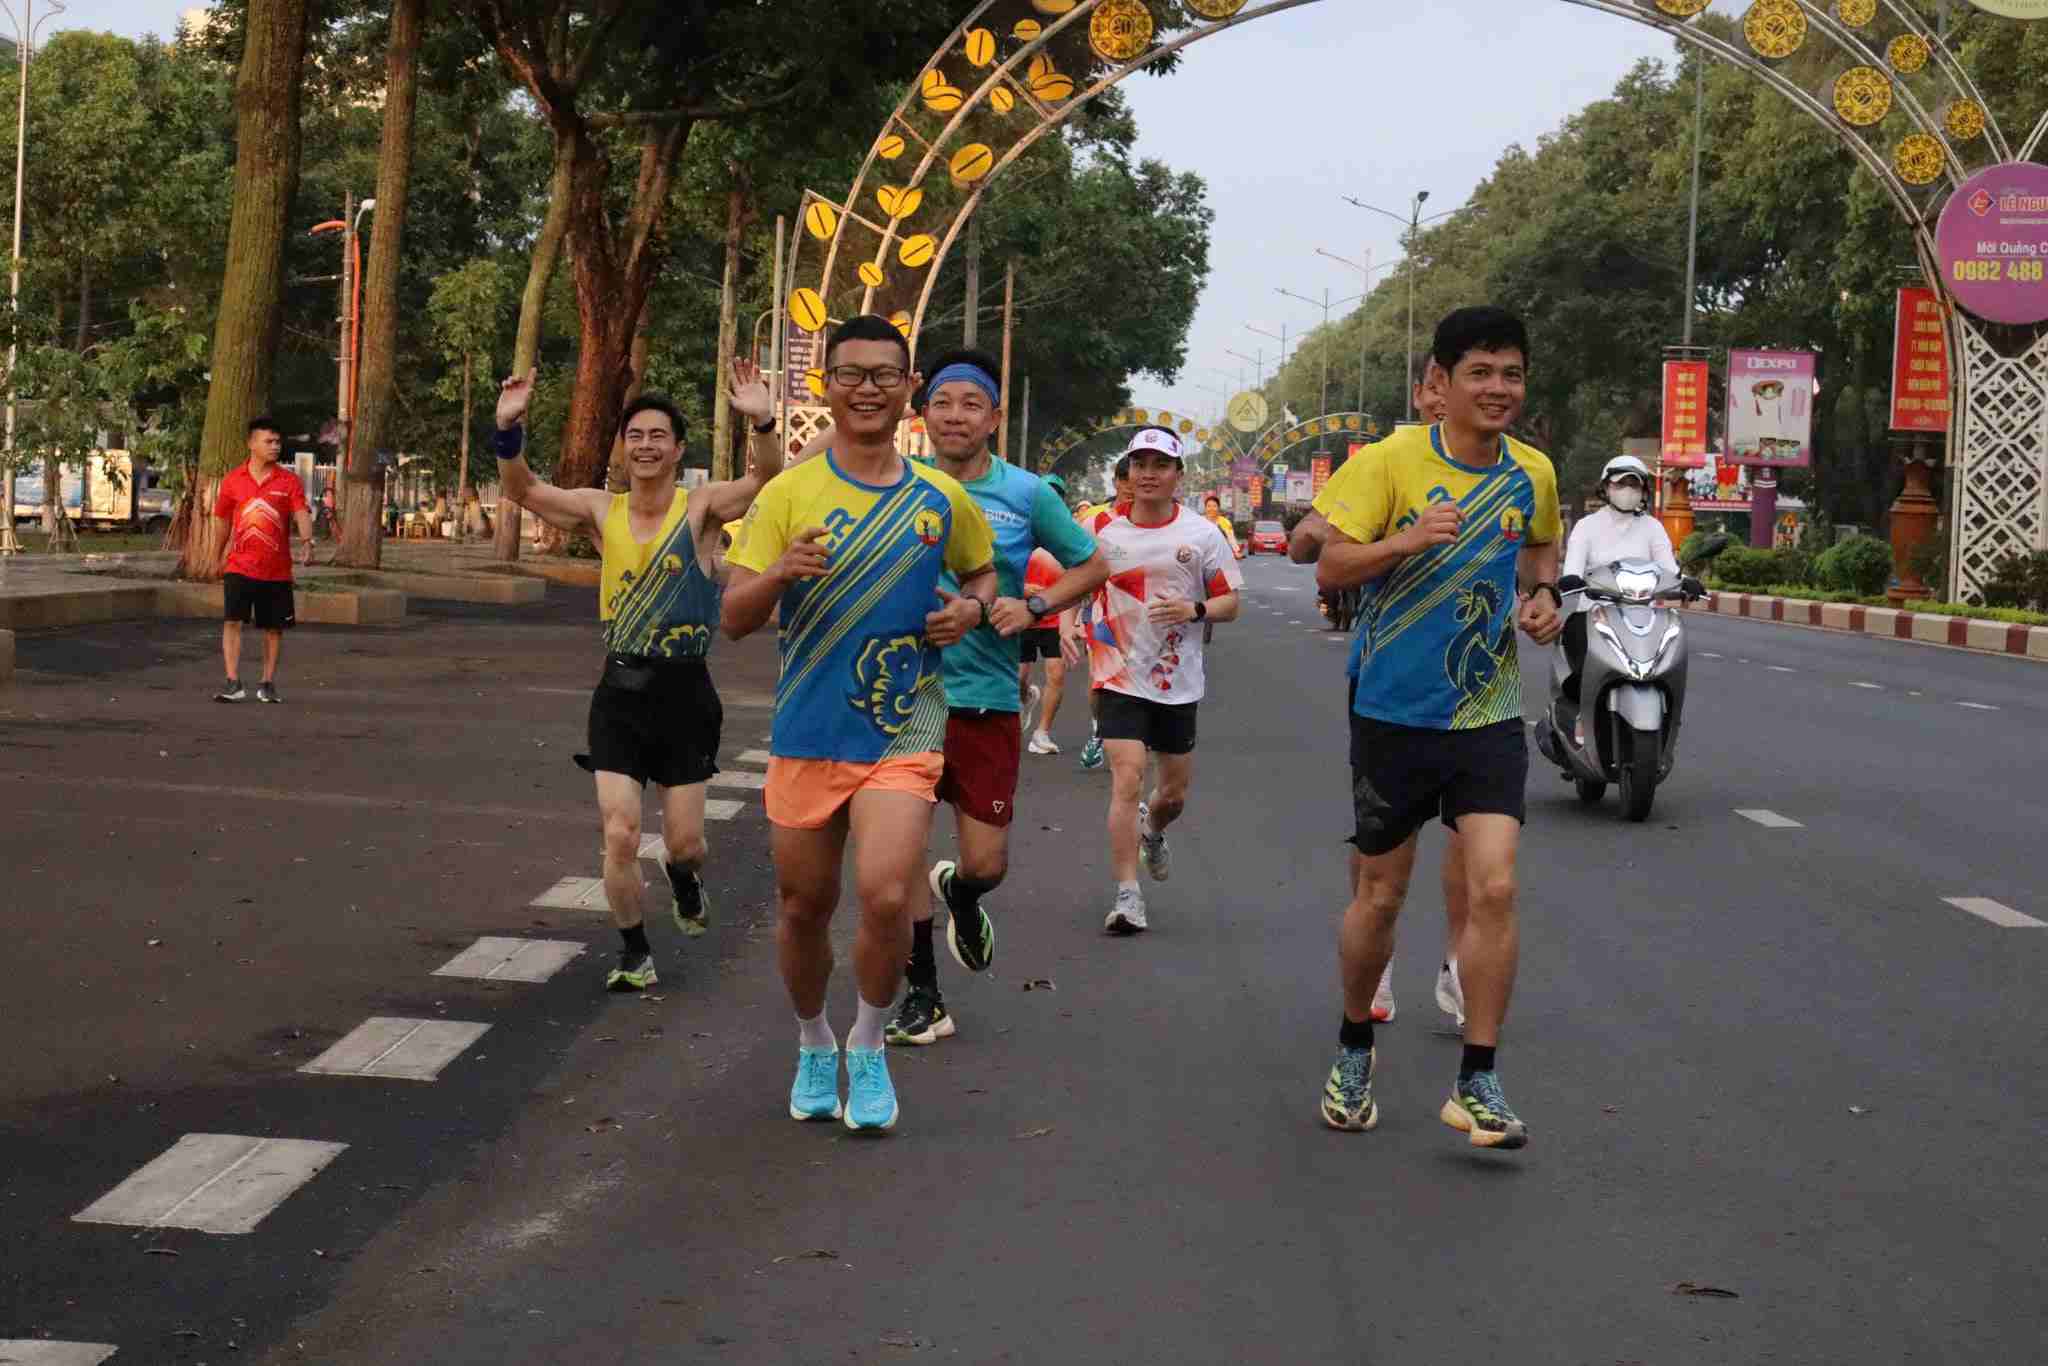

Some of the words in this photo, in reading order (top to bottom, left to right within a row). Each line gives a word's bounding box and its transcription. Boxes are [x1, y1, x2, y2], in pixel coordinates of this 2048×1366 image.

[1999, 240, 2037, 257] Quảng
[1953, 260, 2001, 281] 0982
[2007, 260, 2043, 281] 488
